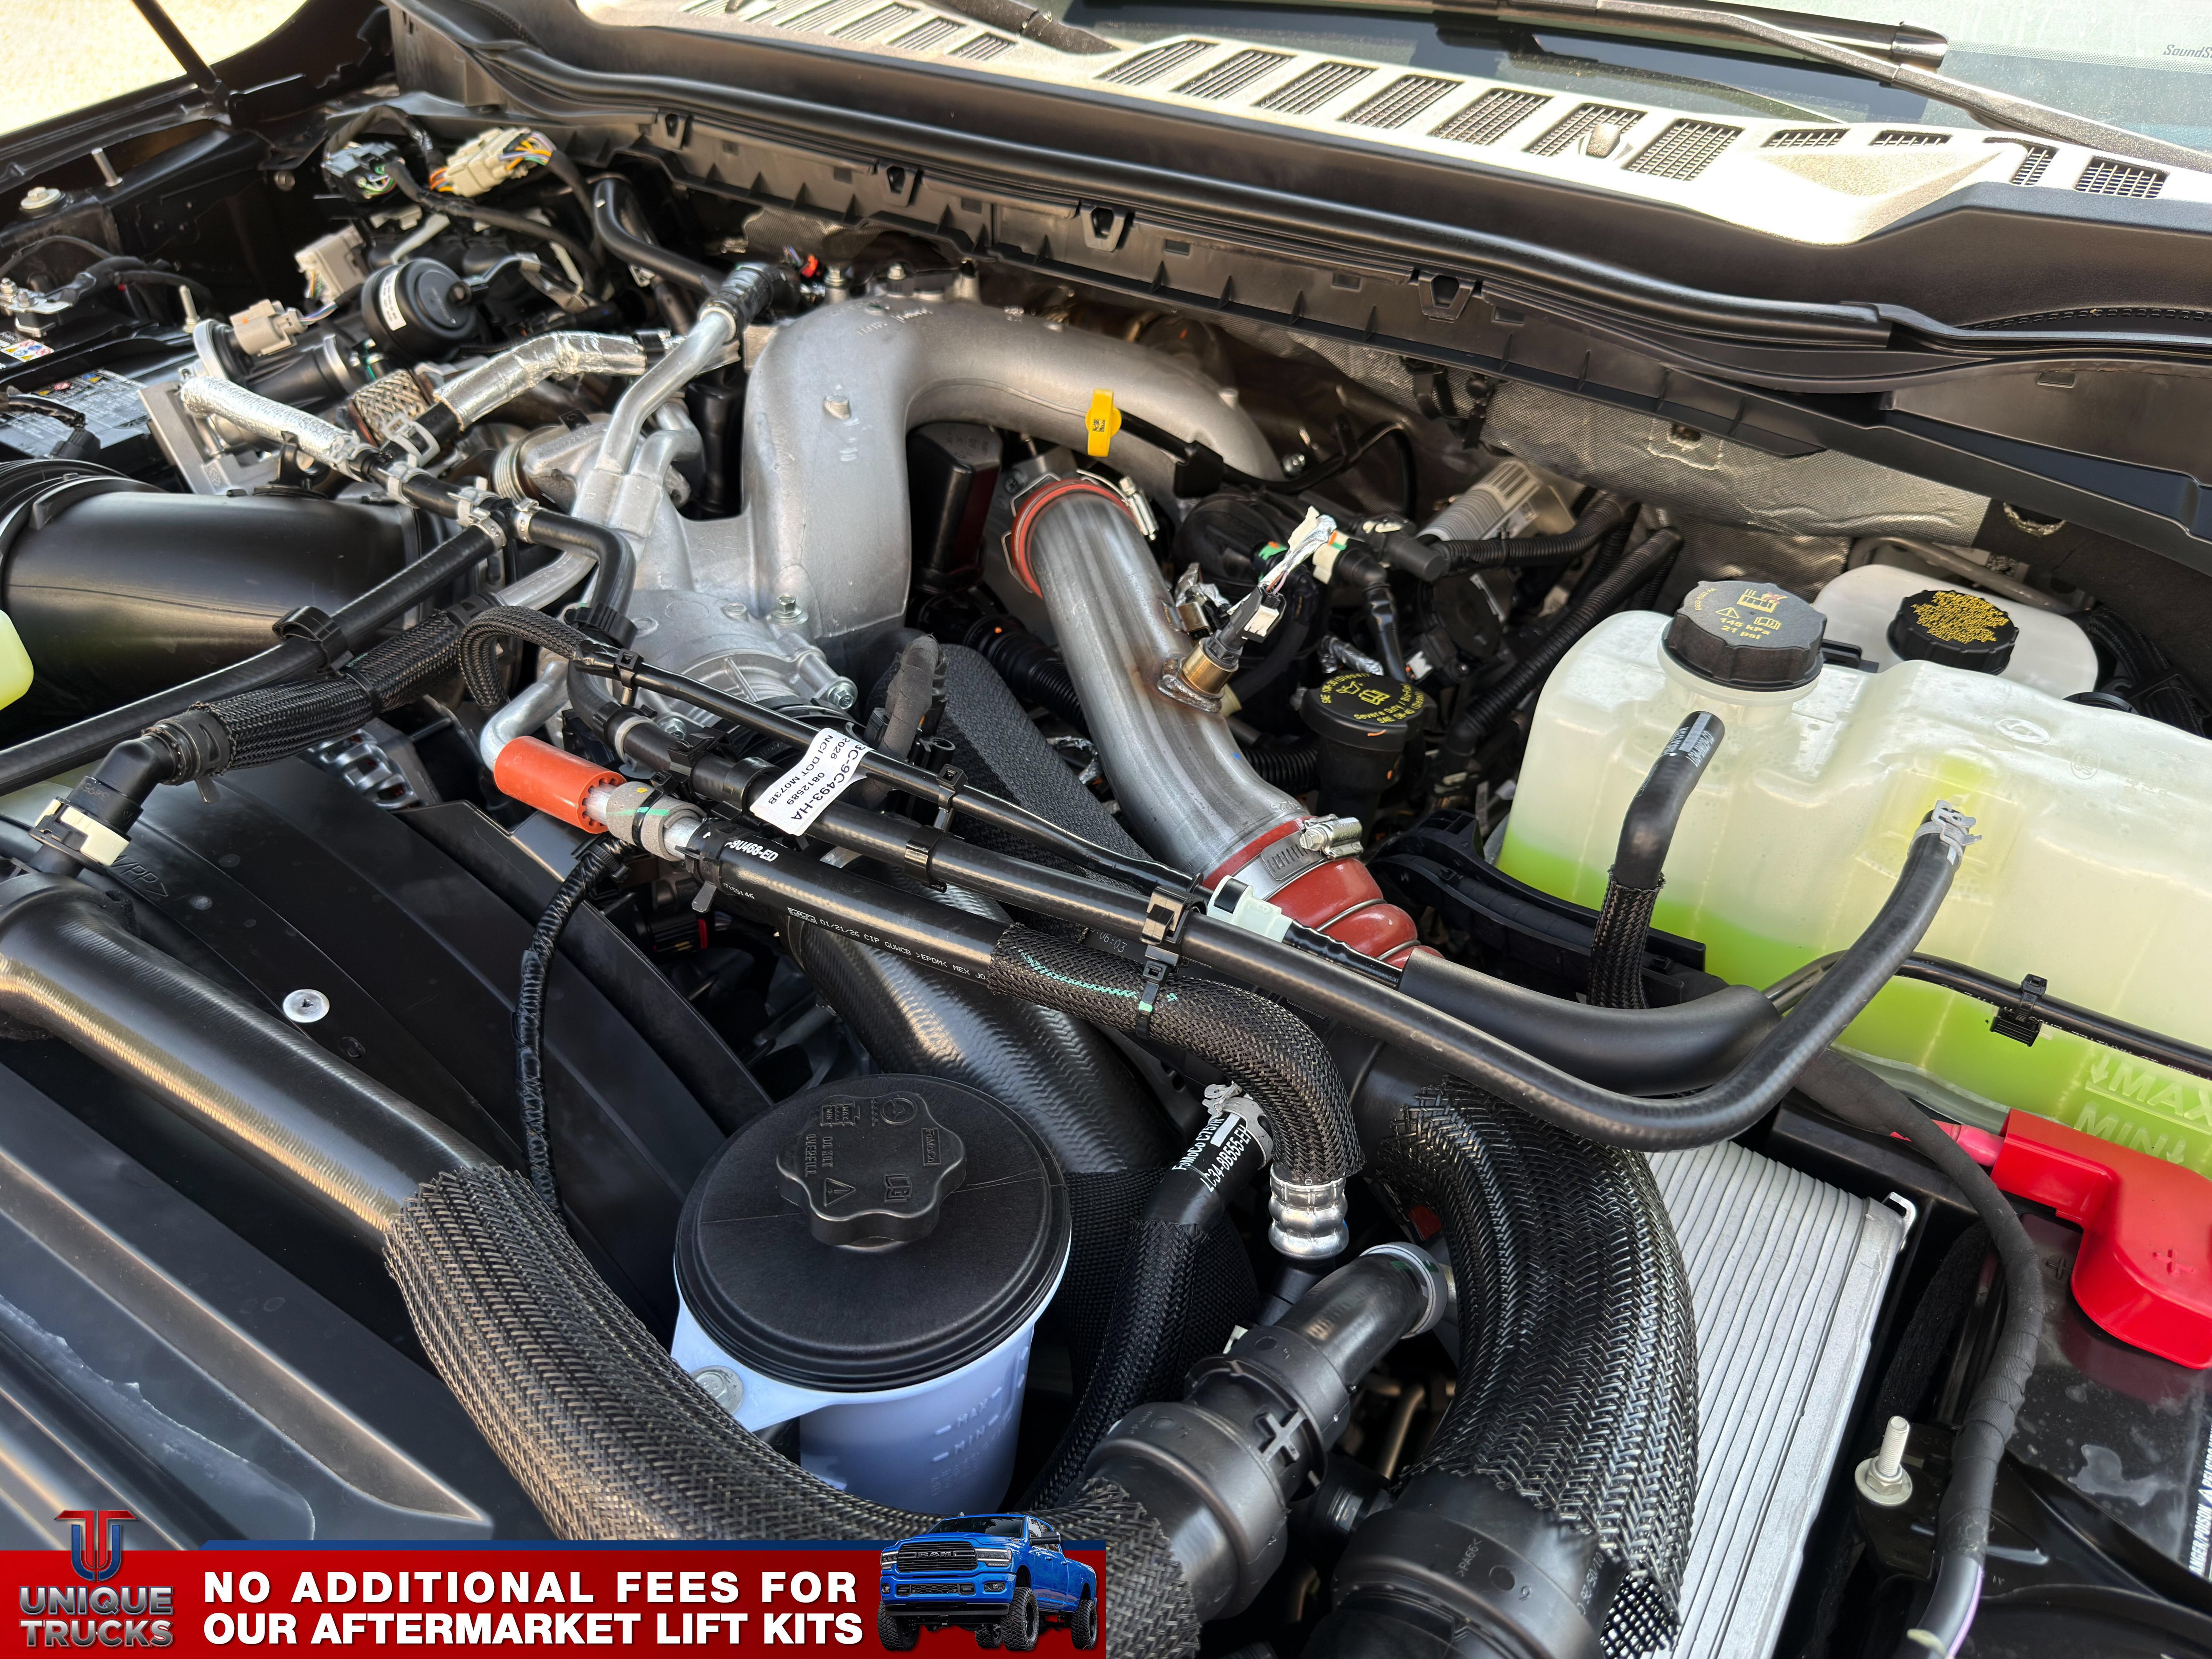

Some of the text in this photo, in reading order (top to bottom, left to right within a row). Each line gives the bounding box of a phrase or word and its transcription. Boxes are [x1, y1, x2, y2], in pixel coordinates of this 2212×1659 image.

[2163, 44, 2212, 58] SoundS
[1911, 603, 1934, 615] AVANT
[1921, 603, 1955, 619] NETTOYER
[1962, 620, 1995, 636] BOUCHON
[1932, 593, 1951, 603] ONLY
[1949, 601, 1964, 609] DOT
[1967, 608, 1987, 619] FLUID
[1985, 616, 2005, 626] FROM
[1935, 591, 1962, 603] BEFORE
[1993, 615, 2009, 623] USE
[1937, 600, 1963, 613] SEALED
[1988, 608, 2004, 616] CAP
[1720, 618, 1770, 635] 145 kPa
[1720, 625, 1762, 640] 21 psi
[1913, 609, 1940, 622] PLOYER
[1937, 619, 1953, 628] QUE
[1960, 629, 1988, 642] LIQUIDE
[1917, 615, 1934, 624] DOT
[1936, 623, 1975, 642] PROVENANT
[1926, 628, 1952, 642] SCELLE
[1930, 625, 1971, 644] CONTENANT
[1320, 694, 1332, 704] SAE
[1354, 711, 1385, 720] Severe
[1383, 704, 1405, 714] Duty
[1393, 708, 1416, 720] 5W-40
[768, 735, 834, 804] NCI DOT M073B
[786, 738, 851, 805] 2026 0812589
[791, 744, 866, 821] 3C-9C493-HA
[724, 840, 779, 862] -9U468-ED
[789, 909, 817, 923] FoMoCo
[820, 919, 860, 938] 01/21/26
[864, 934, 880, 943] CIP
[884, 941, 912, 956] GUWCB
[952, 964, 971, 976] MEX
[975, 972, 989, 982] JO
[2109, 1060, 2212, 1127] MAX
[2073, 1100, 2169, 1157] MIN
[805, 1133, 817, 1177] OVERFILL
[925, 1128, 937, 1164] FoMoCo
[1171, 1142, 1206, 1171] FoMoCo
[957, 1397, 988, 1428] MAX
[954, 1424, 986, 1455] MIN
[2189, 1503, 2212, 1575] ANGER/POISON
